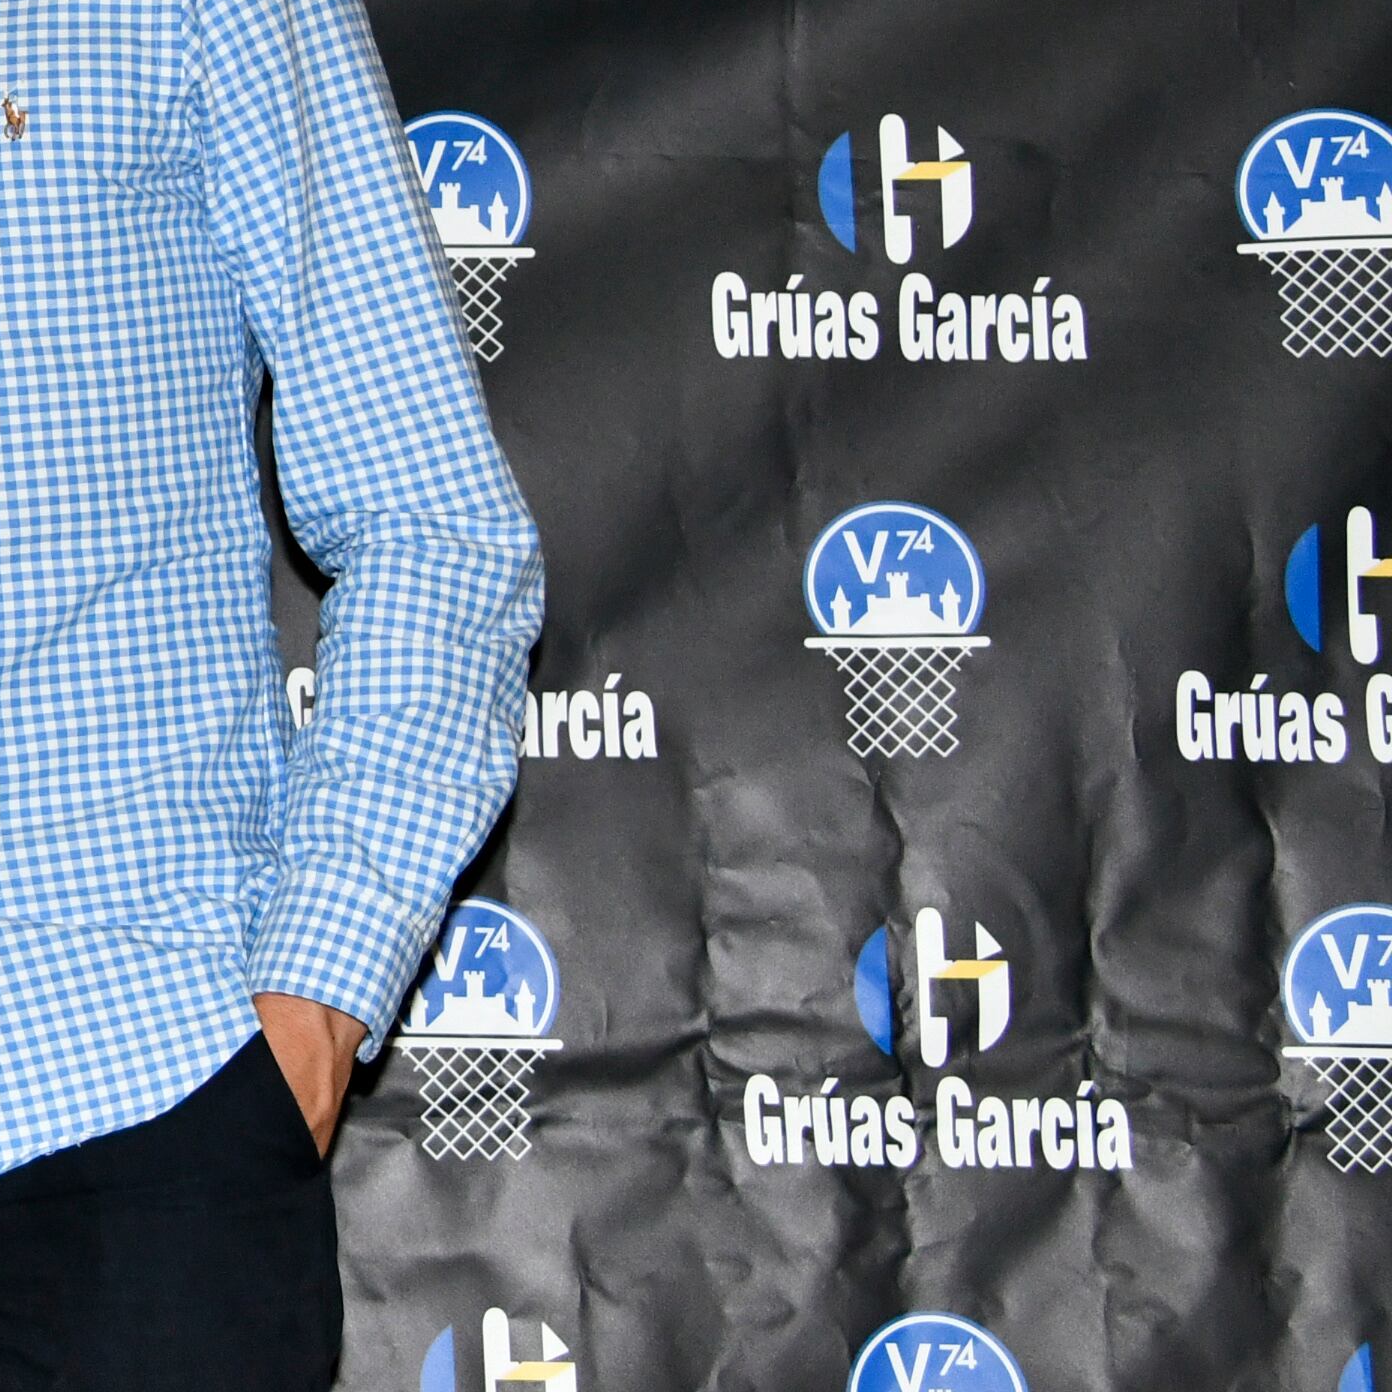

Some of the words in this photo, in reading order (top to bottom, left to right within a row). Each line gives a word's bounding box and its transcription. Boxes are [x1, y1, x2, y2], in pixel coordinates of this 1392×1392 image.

[712, 271, 879, 360] Grúas
[898, 272, 1088, 362] García
[1177, 671, 1347, 764] Grúas
[744, 1075, 918, 1168] Grúas
[936, 1076, 1134, 1170] García
